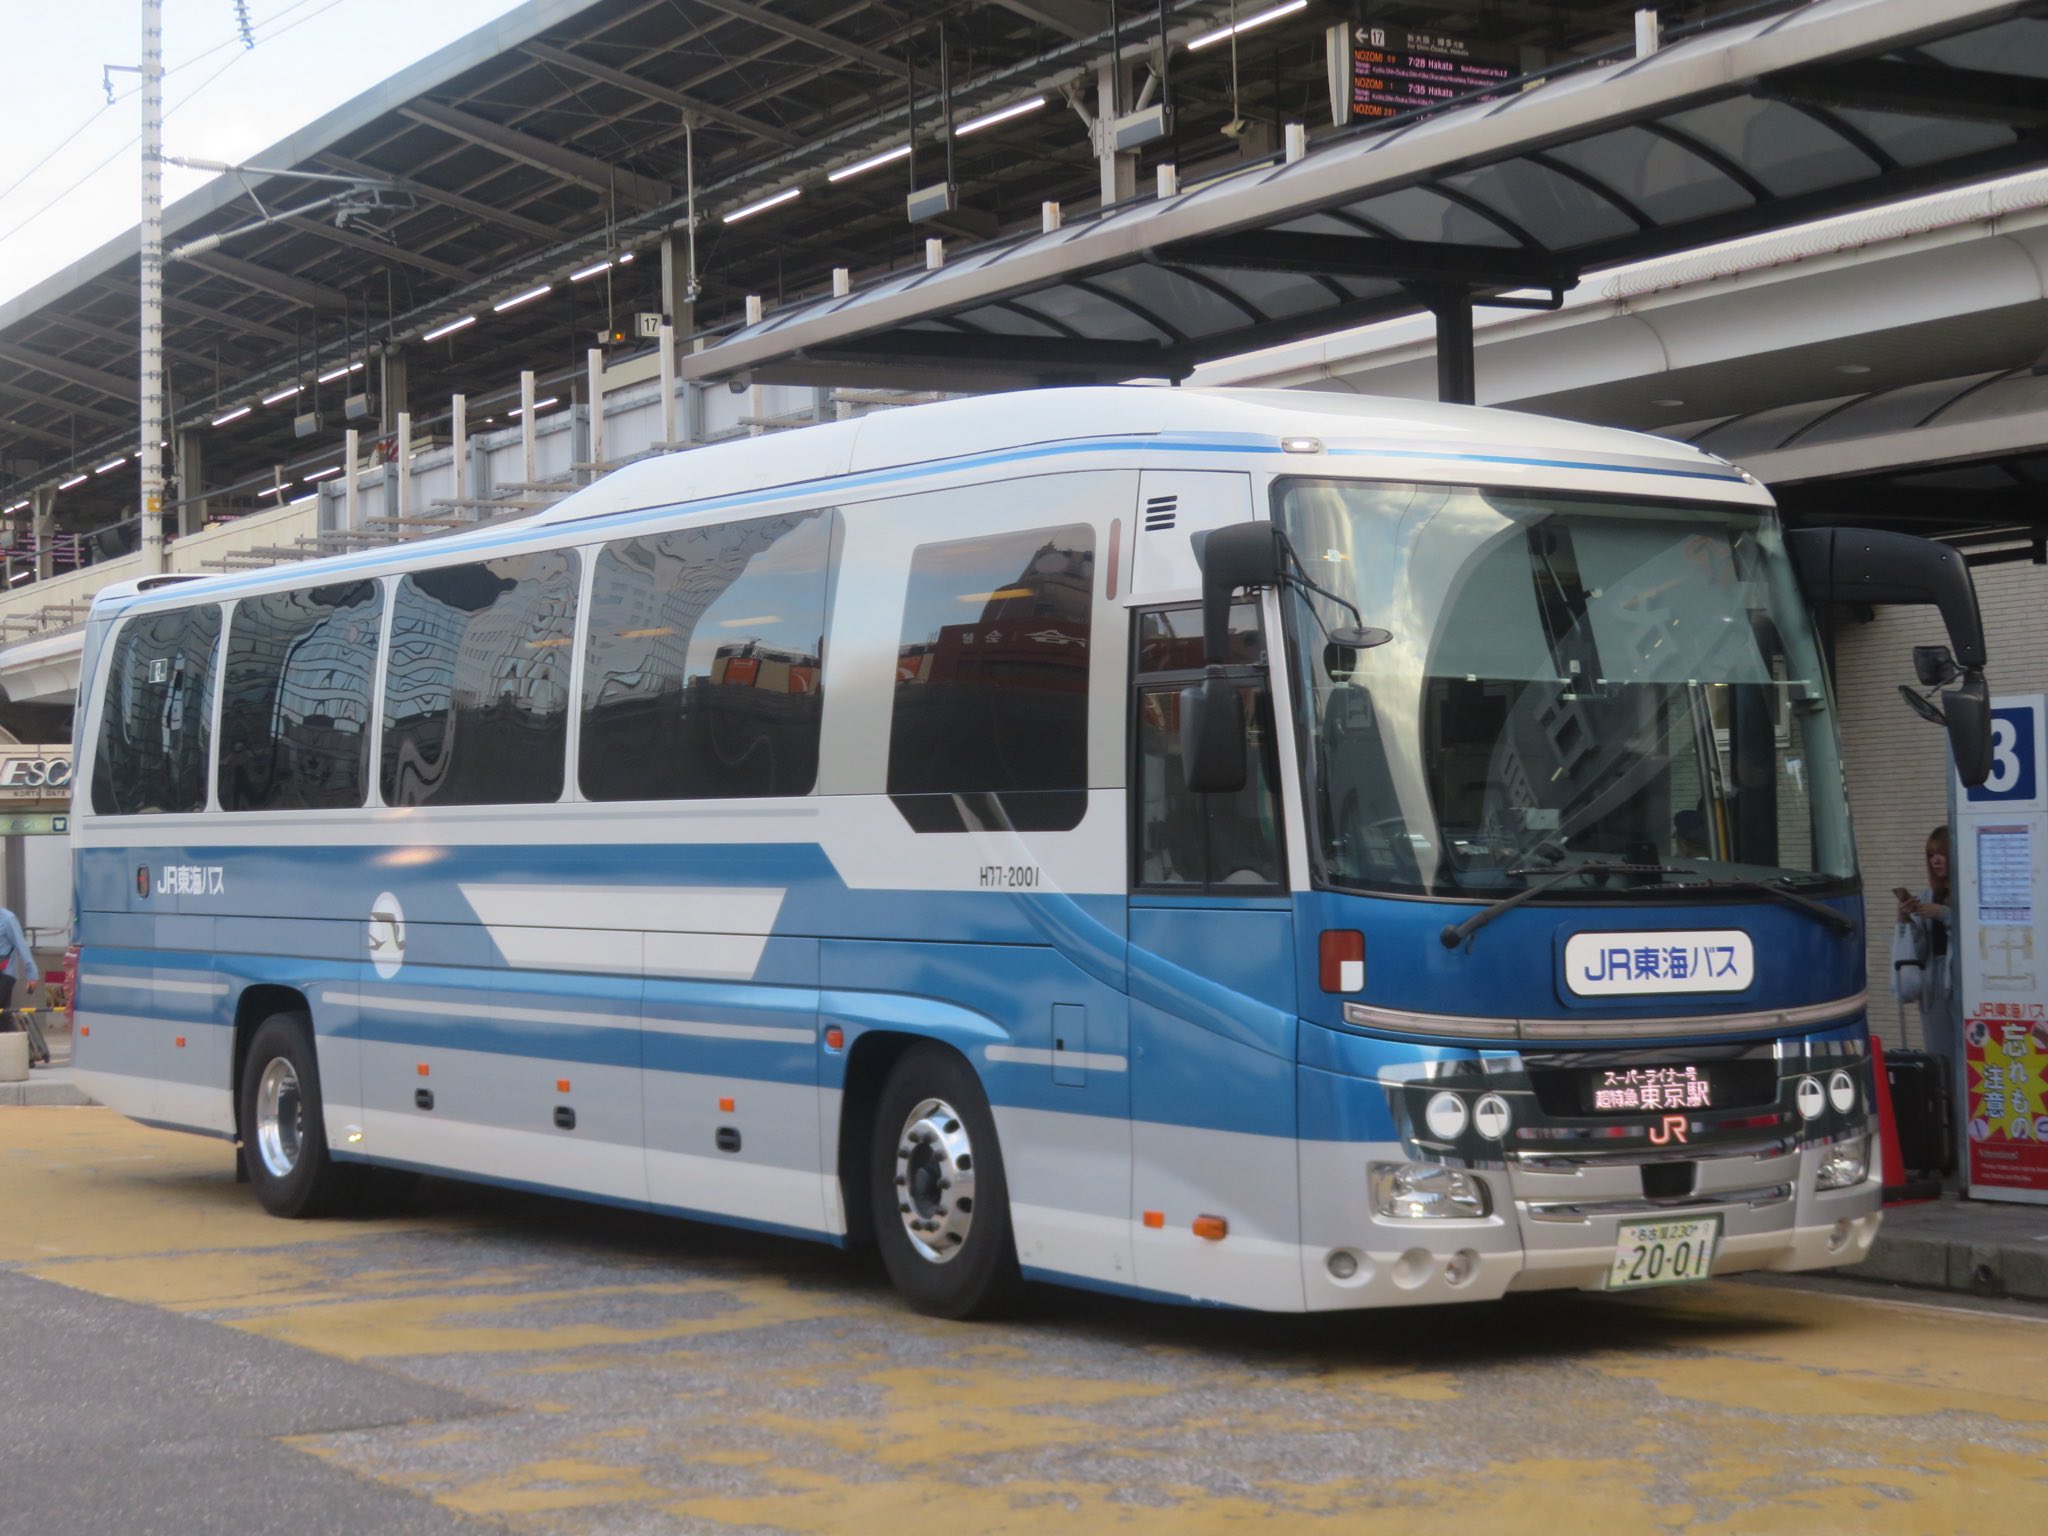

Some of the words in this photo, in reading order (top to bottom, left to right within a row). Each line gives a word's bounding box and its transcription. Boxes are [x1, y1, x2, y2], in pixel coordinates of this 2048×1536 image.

[1373, 31, 1383, 44] 17
[1355, 50, 1383, 63] NOZOMI
[1408, 57, 1426, 68] 7:28
[1428, 60, 1453, 71] Hakata
[1355, 77, 1383, 90] NOZOMI
[1408, 83, 1426, 95] 7:35
[1428, 86, 1453, 98] Hakata
[1353, 104, 1382, 116] NOZOMI
[645, 318, 658, 332] 17
[1984, 718, 2020, 792] 3
[0, 759, 72, 787] ESC
[157, 866, 224, 896] JR東海バス
[980, 865, 1040, 888] H77-2001
[1584, 945, 1738, 981] JR東海バス
[1972, 1002, 2045, 1018] JR東海バス
[1983, 1064, 2005, 1118] 注意
[2001, 1022, 2030, 1139] 忘れもの
[1649, 1115, 1688, 1144] JR
[1628, 1239, 1705, 1280] 20-01
